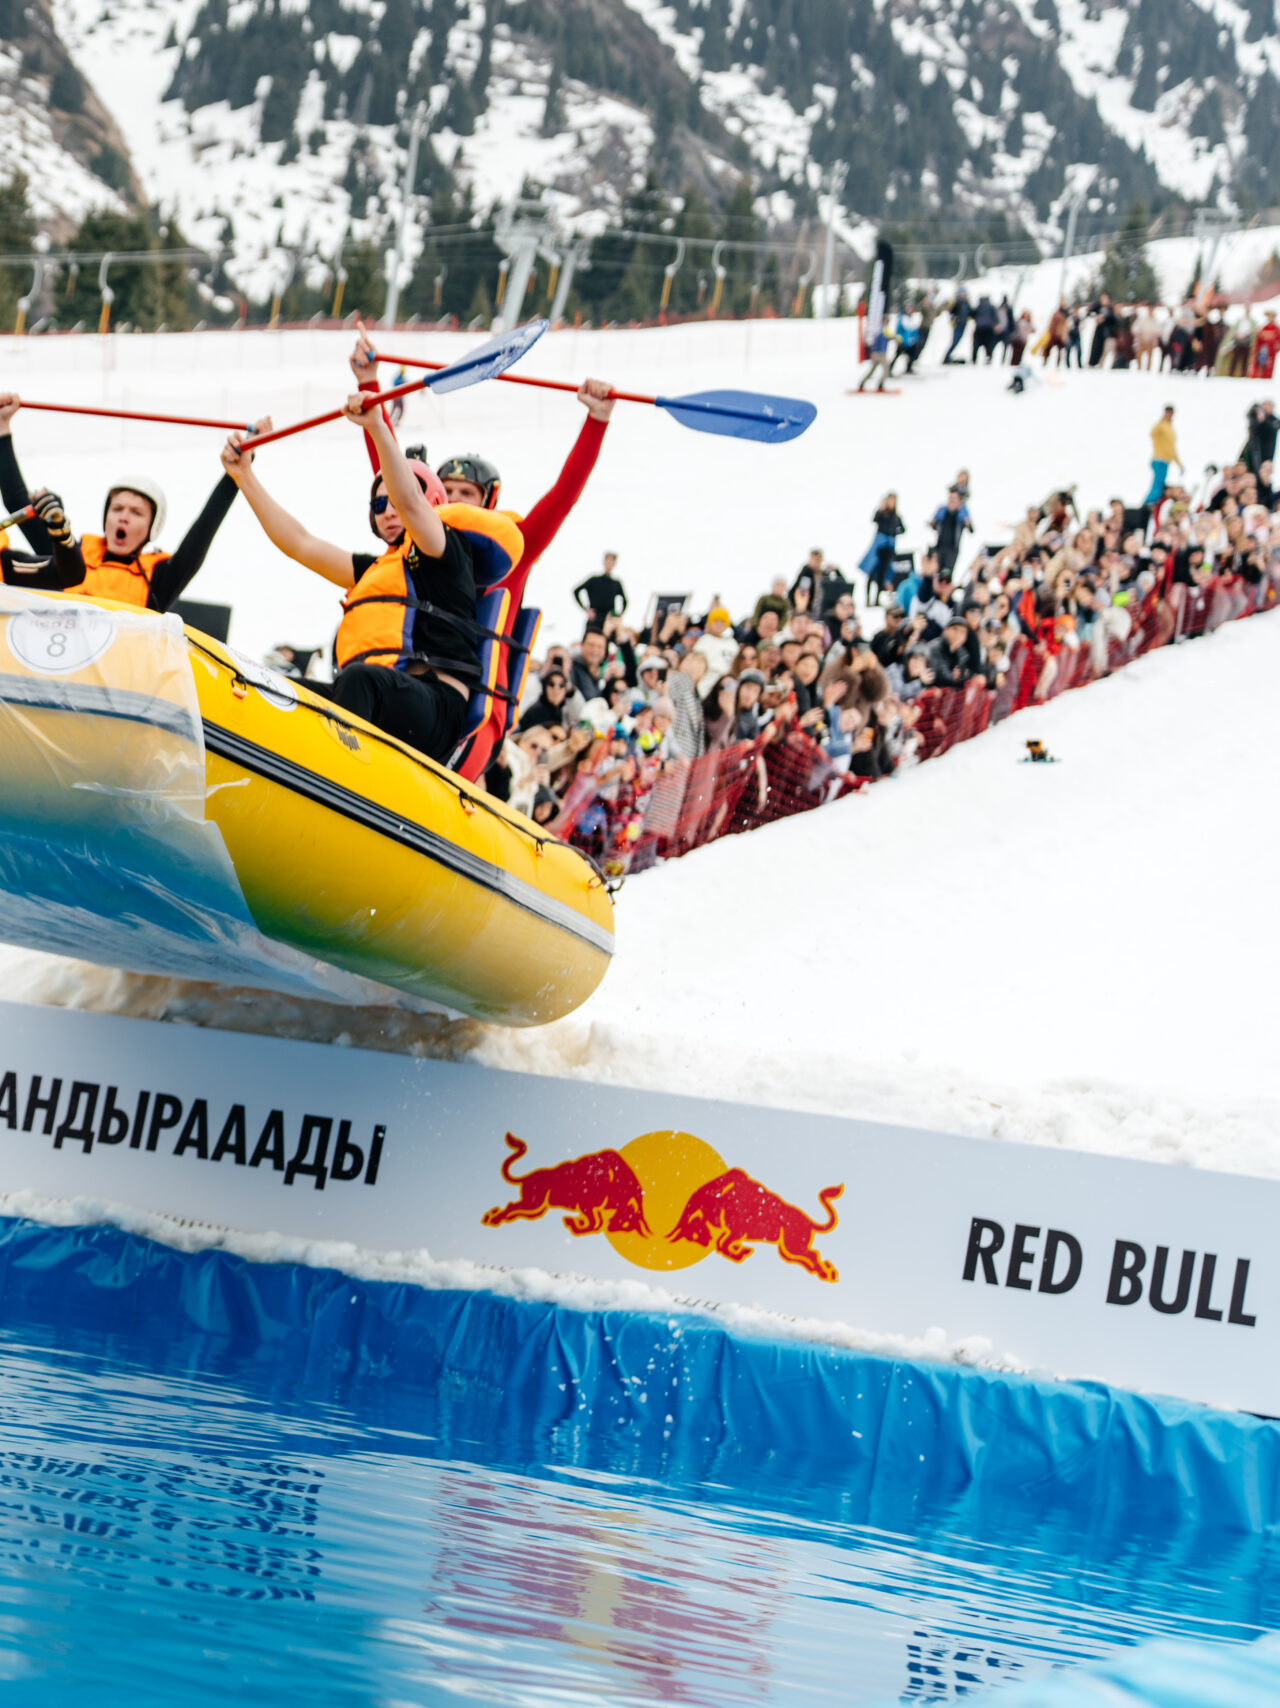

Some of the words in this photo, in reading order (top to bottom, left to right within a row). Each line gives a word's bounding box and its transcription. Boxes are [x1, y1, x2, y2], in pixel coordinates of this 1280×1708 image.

[46, 632, 67, 657] 8
[962, 1216, 1083, 1296] RED
[1106, 1238, 1258, 1327] BULL
